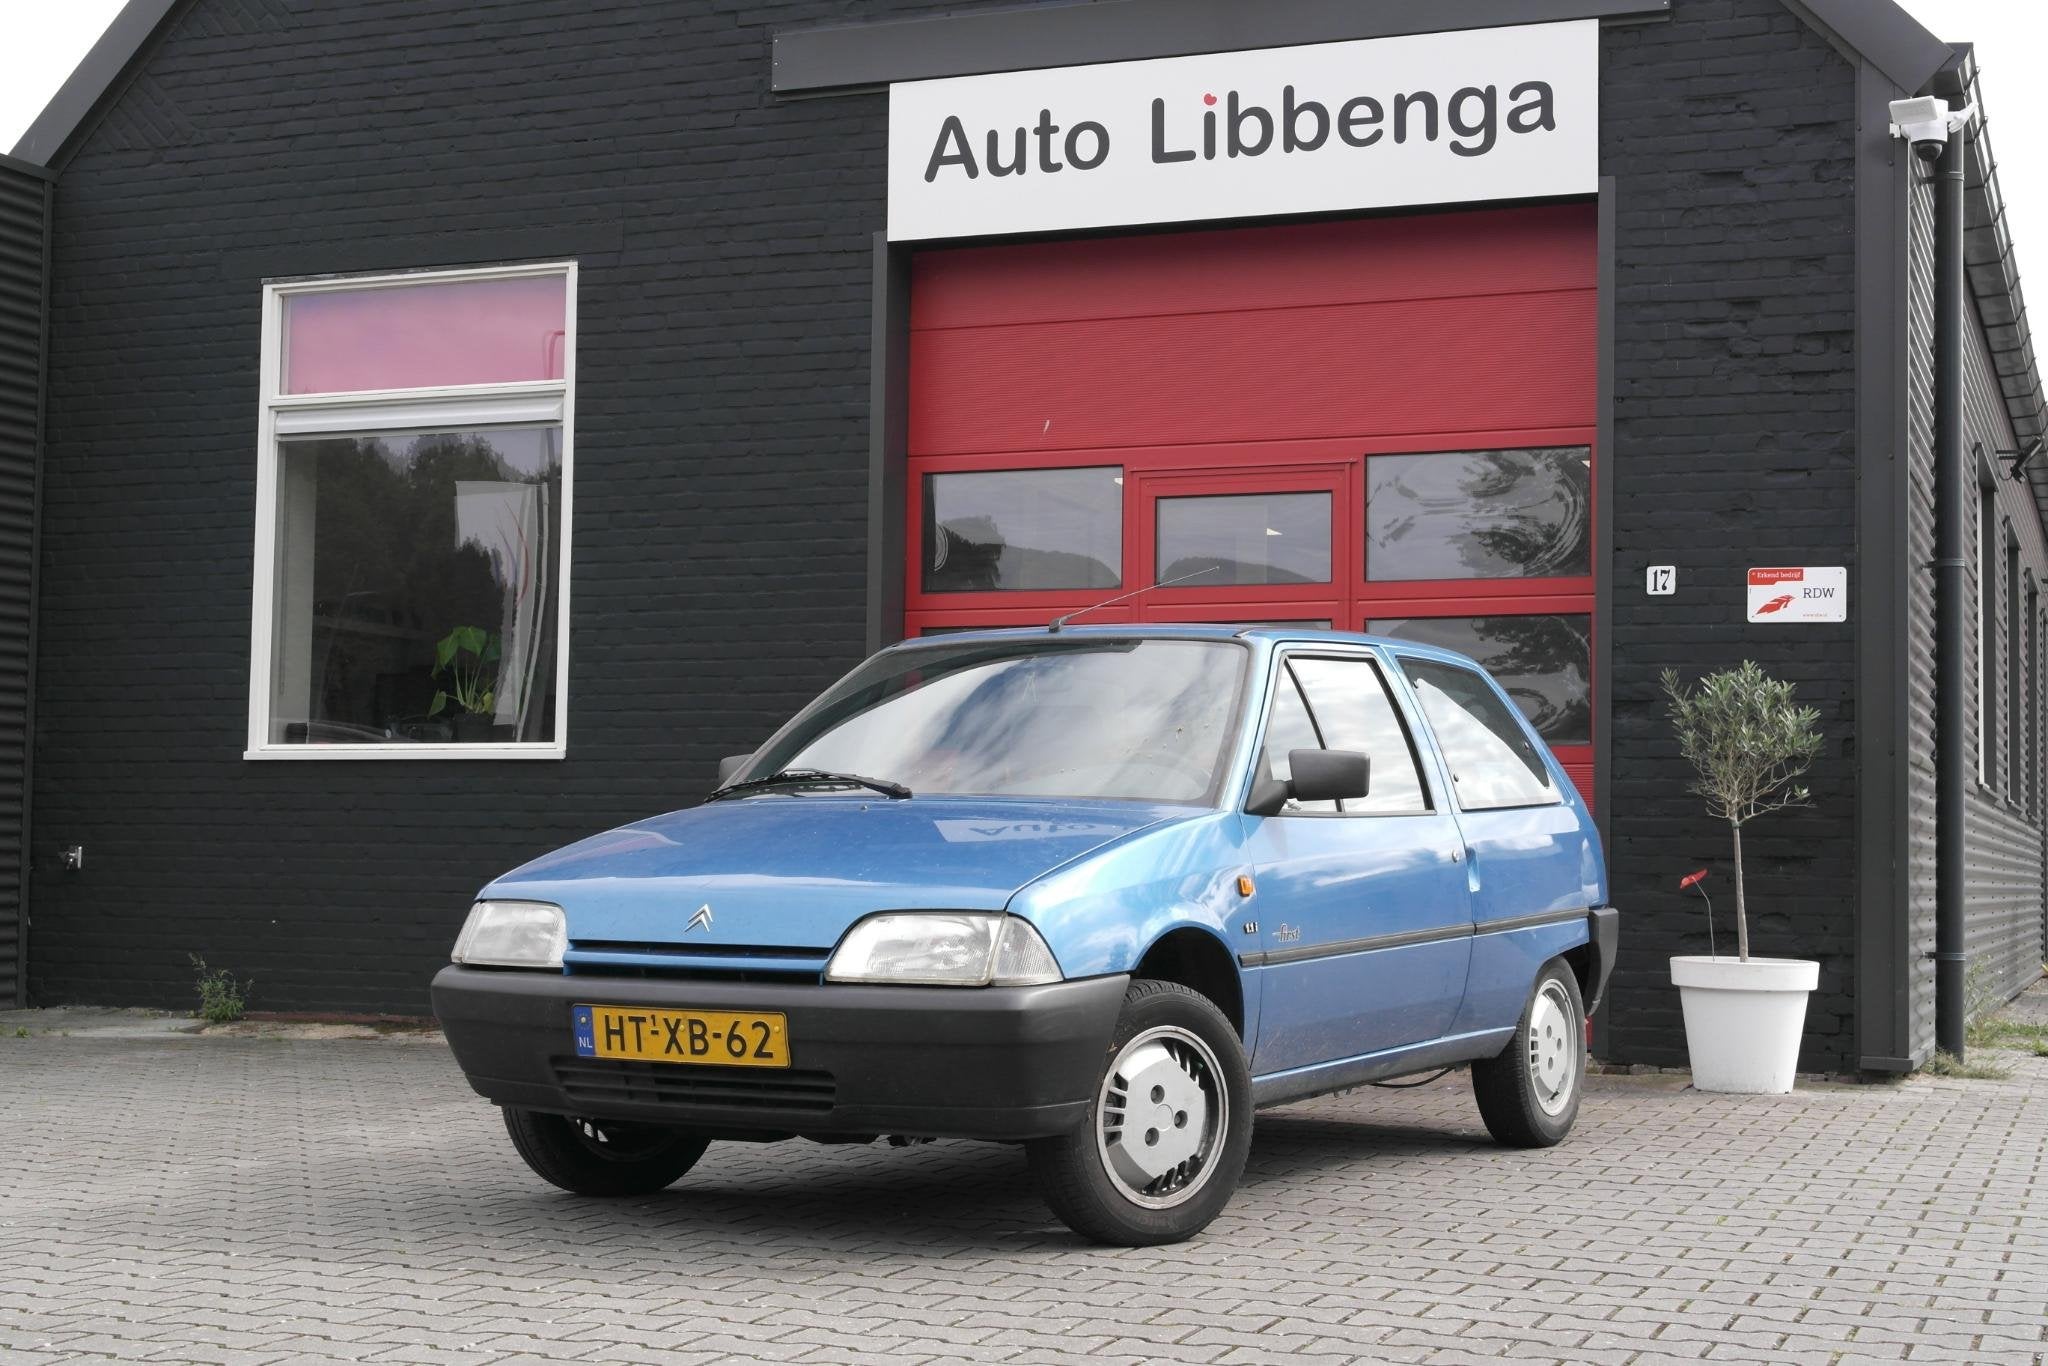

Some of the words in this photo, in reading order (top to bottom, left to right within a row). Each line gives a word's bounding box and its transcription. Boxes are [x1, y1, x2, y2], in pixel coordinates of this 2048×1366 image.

[924, 109, 1111, 184] Auto
[1151, 80, 1556, 163] Libbenga
[1652, 569, 1671, 592] 17
[1803, 587, 1835, 599] RDW
[579, 1036, 592, 1048] NL
